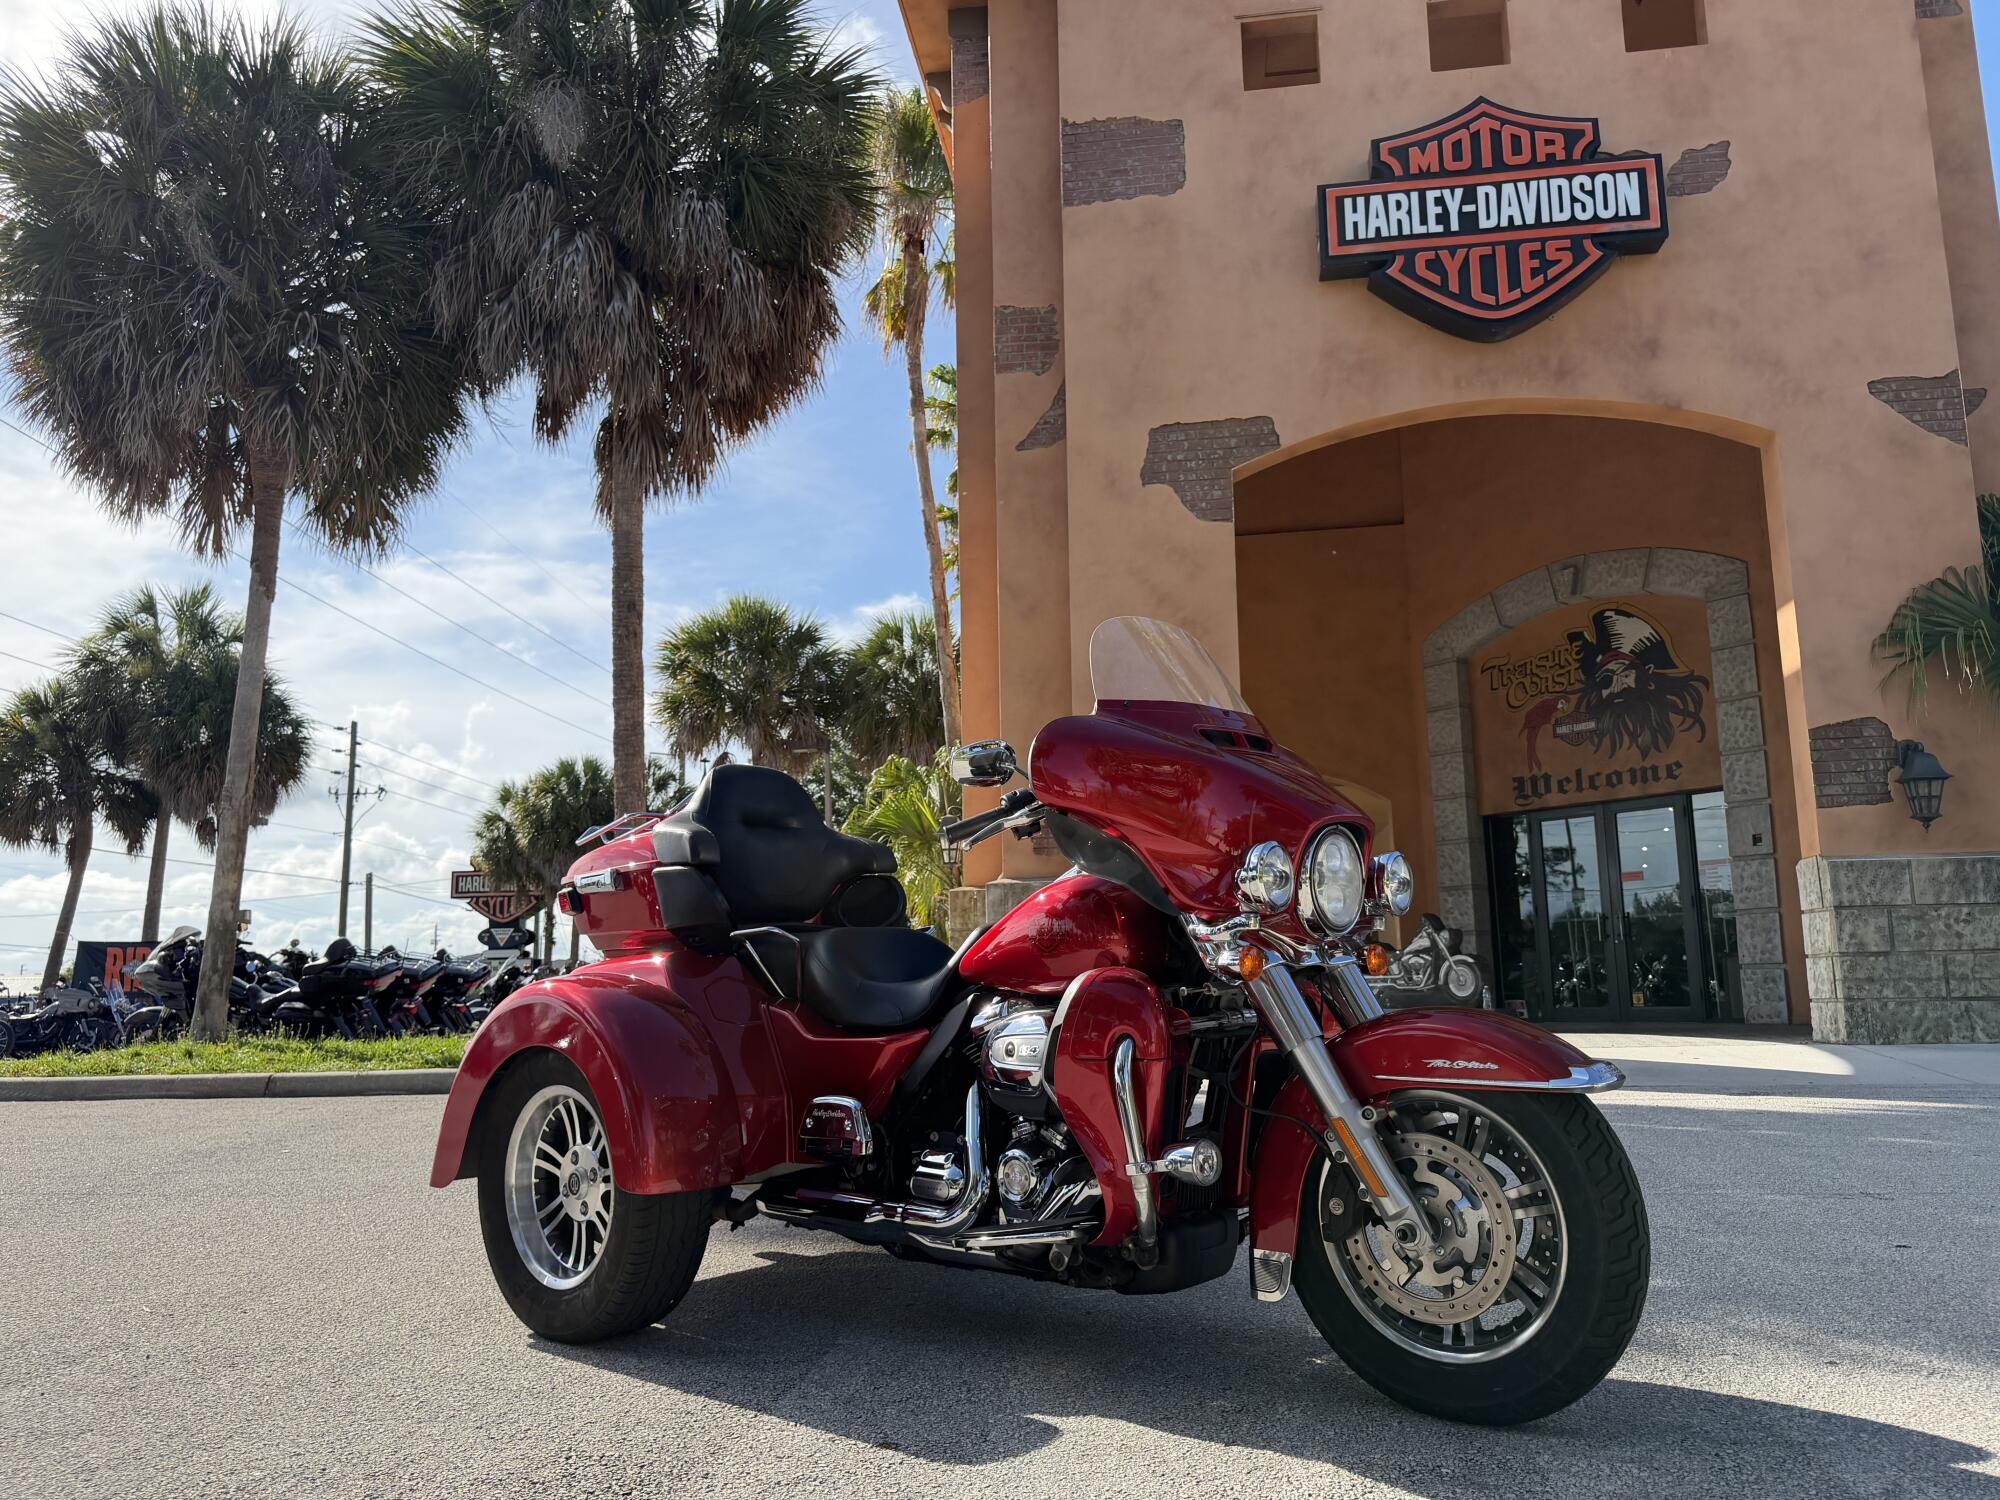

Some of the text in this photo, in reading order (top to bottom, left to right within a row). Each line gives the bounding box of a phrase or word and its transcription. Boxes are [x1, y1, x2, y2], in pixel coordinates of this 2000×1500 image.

[1408, 116, 1566, 175] MOTOR
[1343, 171, 1641, 241] HARLEY-DAVIDSON
[1414, 239, 1574, 305] CYCLES
[1511, 759, 1683, 807] Welcome
[479, 896, 521, 918] CYCL
